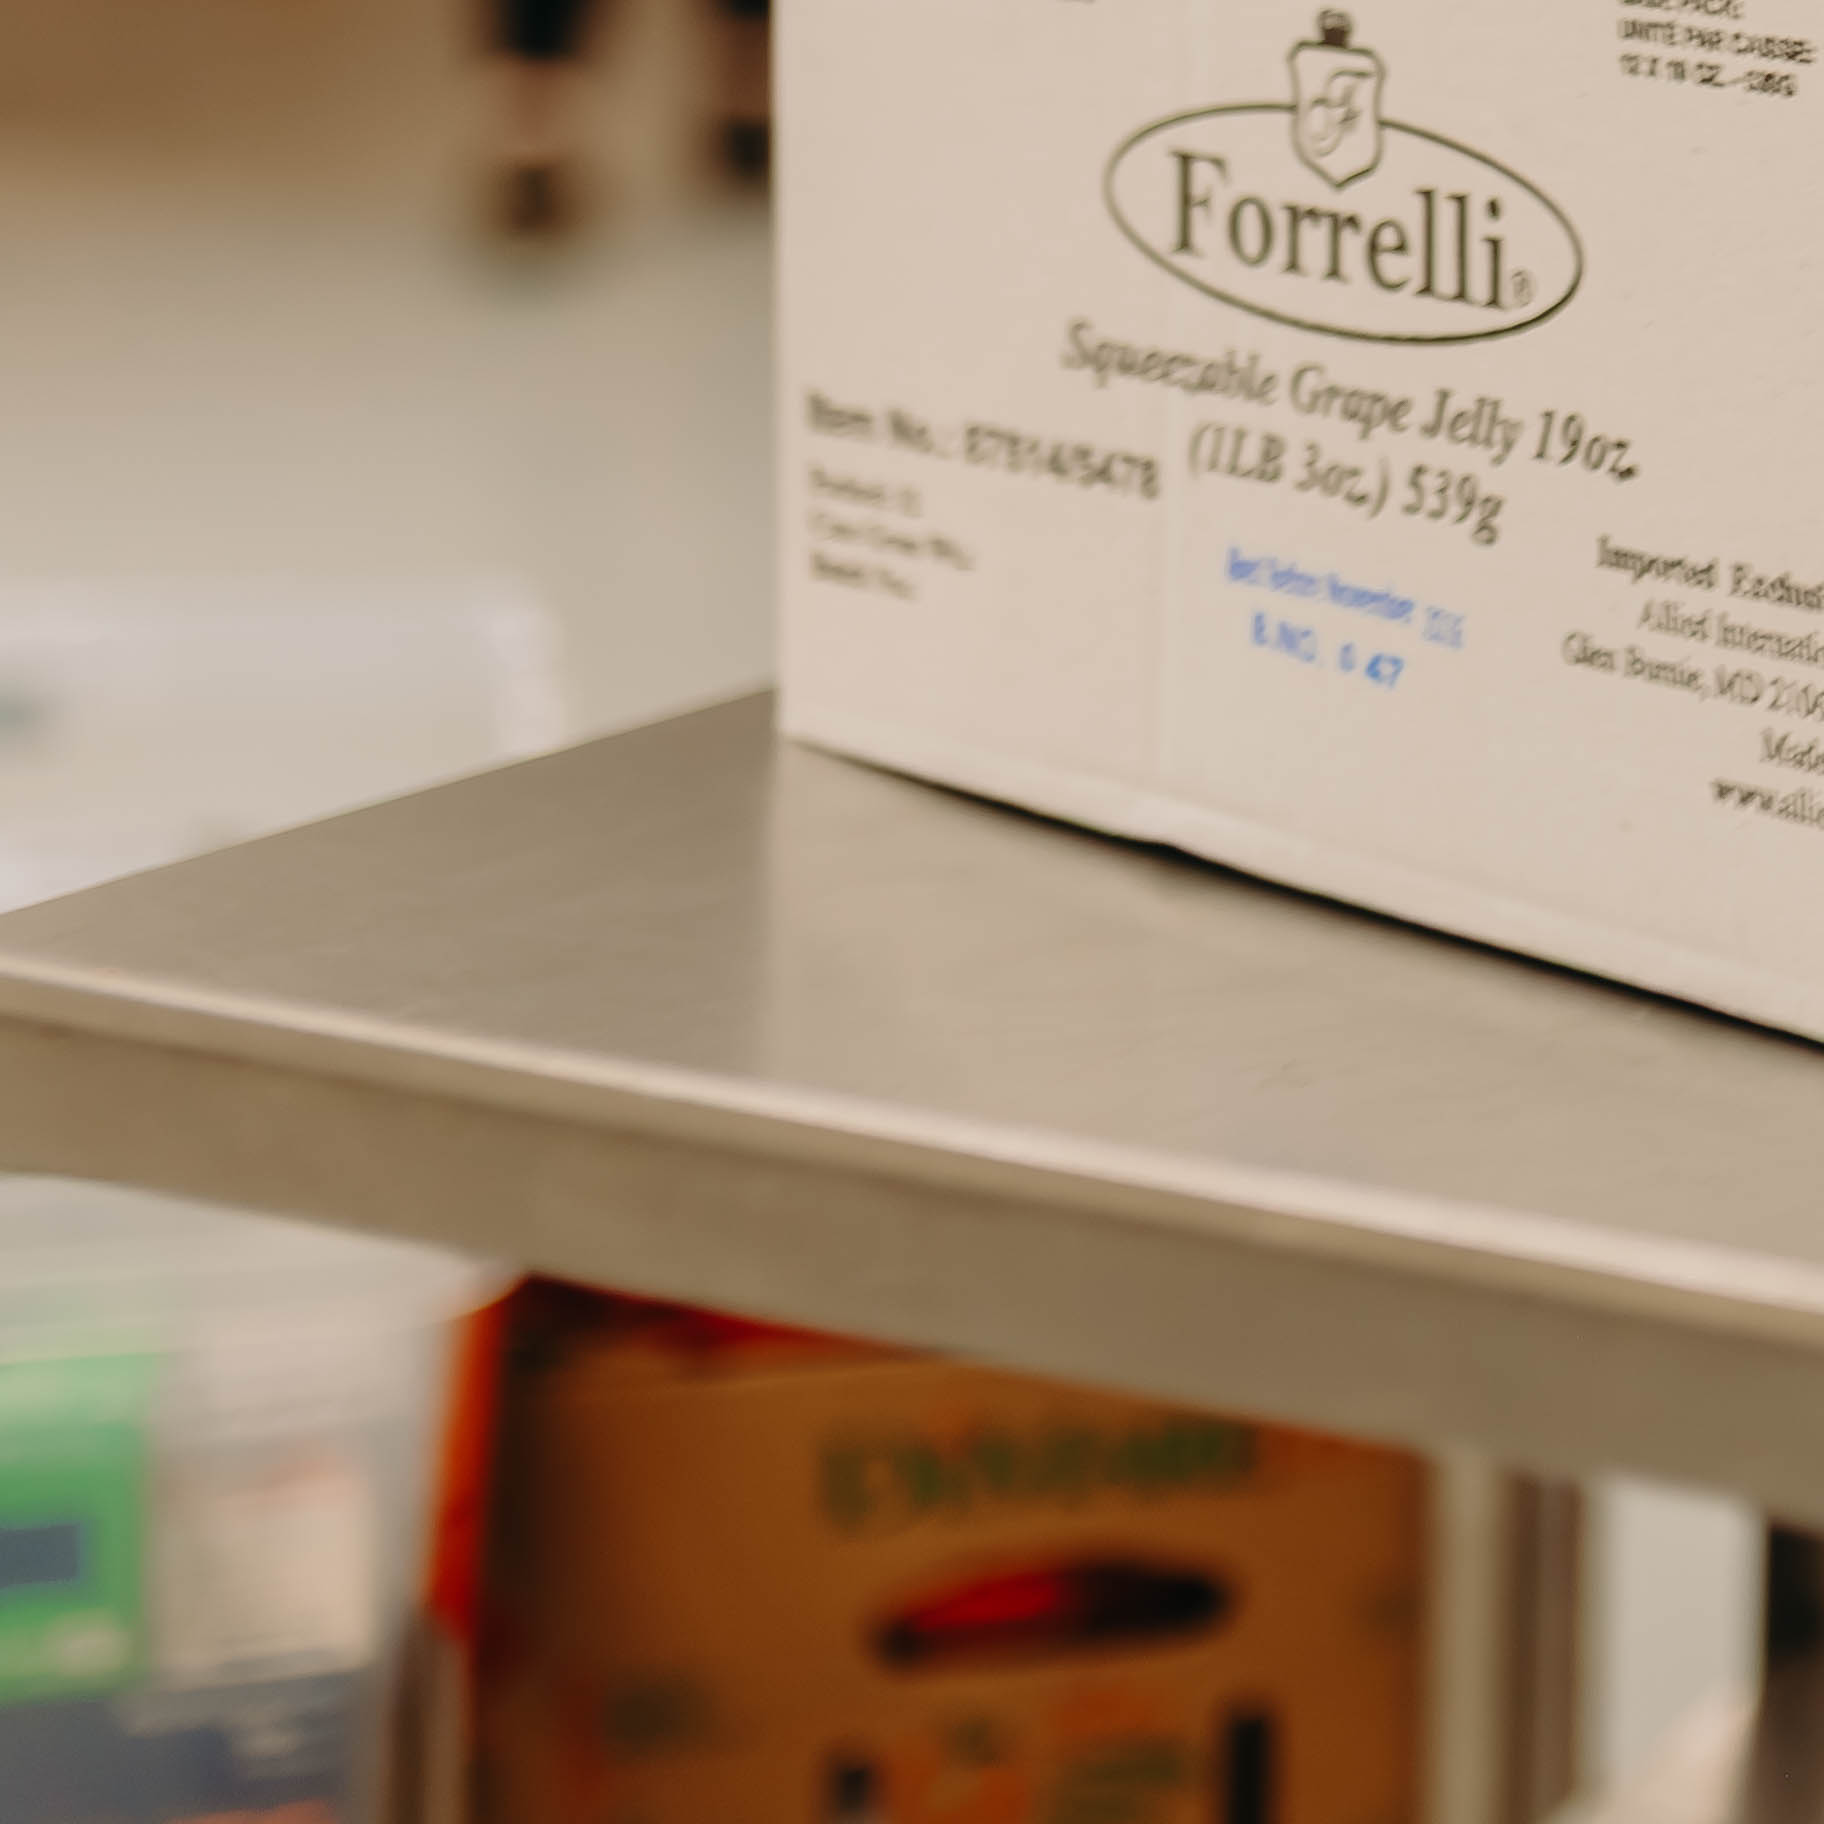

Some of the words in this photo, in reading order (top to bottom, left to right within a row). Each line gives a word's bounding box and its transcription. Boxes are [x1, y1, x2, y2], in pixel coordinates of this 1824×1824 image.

[1166, 148, 1507, 311] Forrelli
[1061, 316, 1280, 409] Squeezable
[1287, 362, 1413, 442] Grape
[1420, 386, 1526, 464] Jelly
[1401, 462, 1506, 547] 539g
